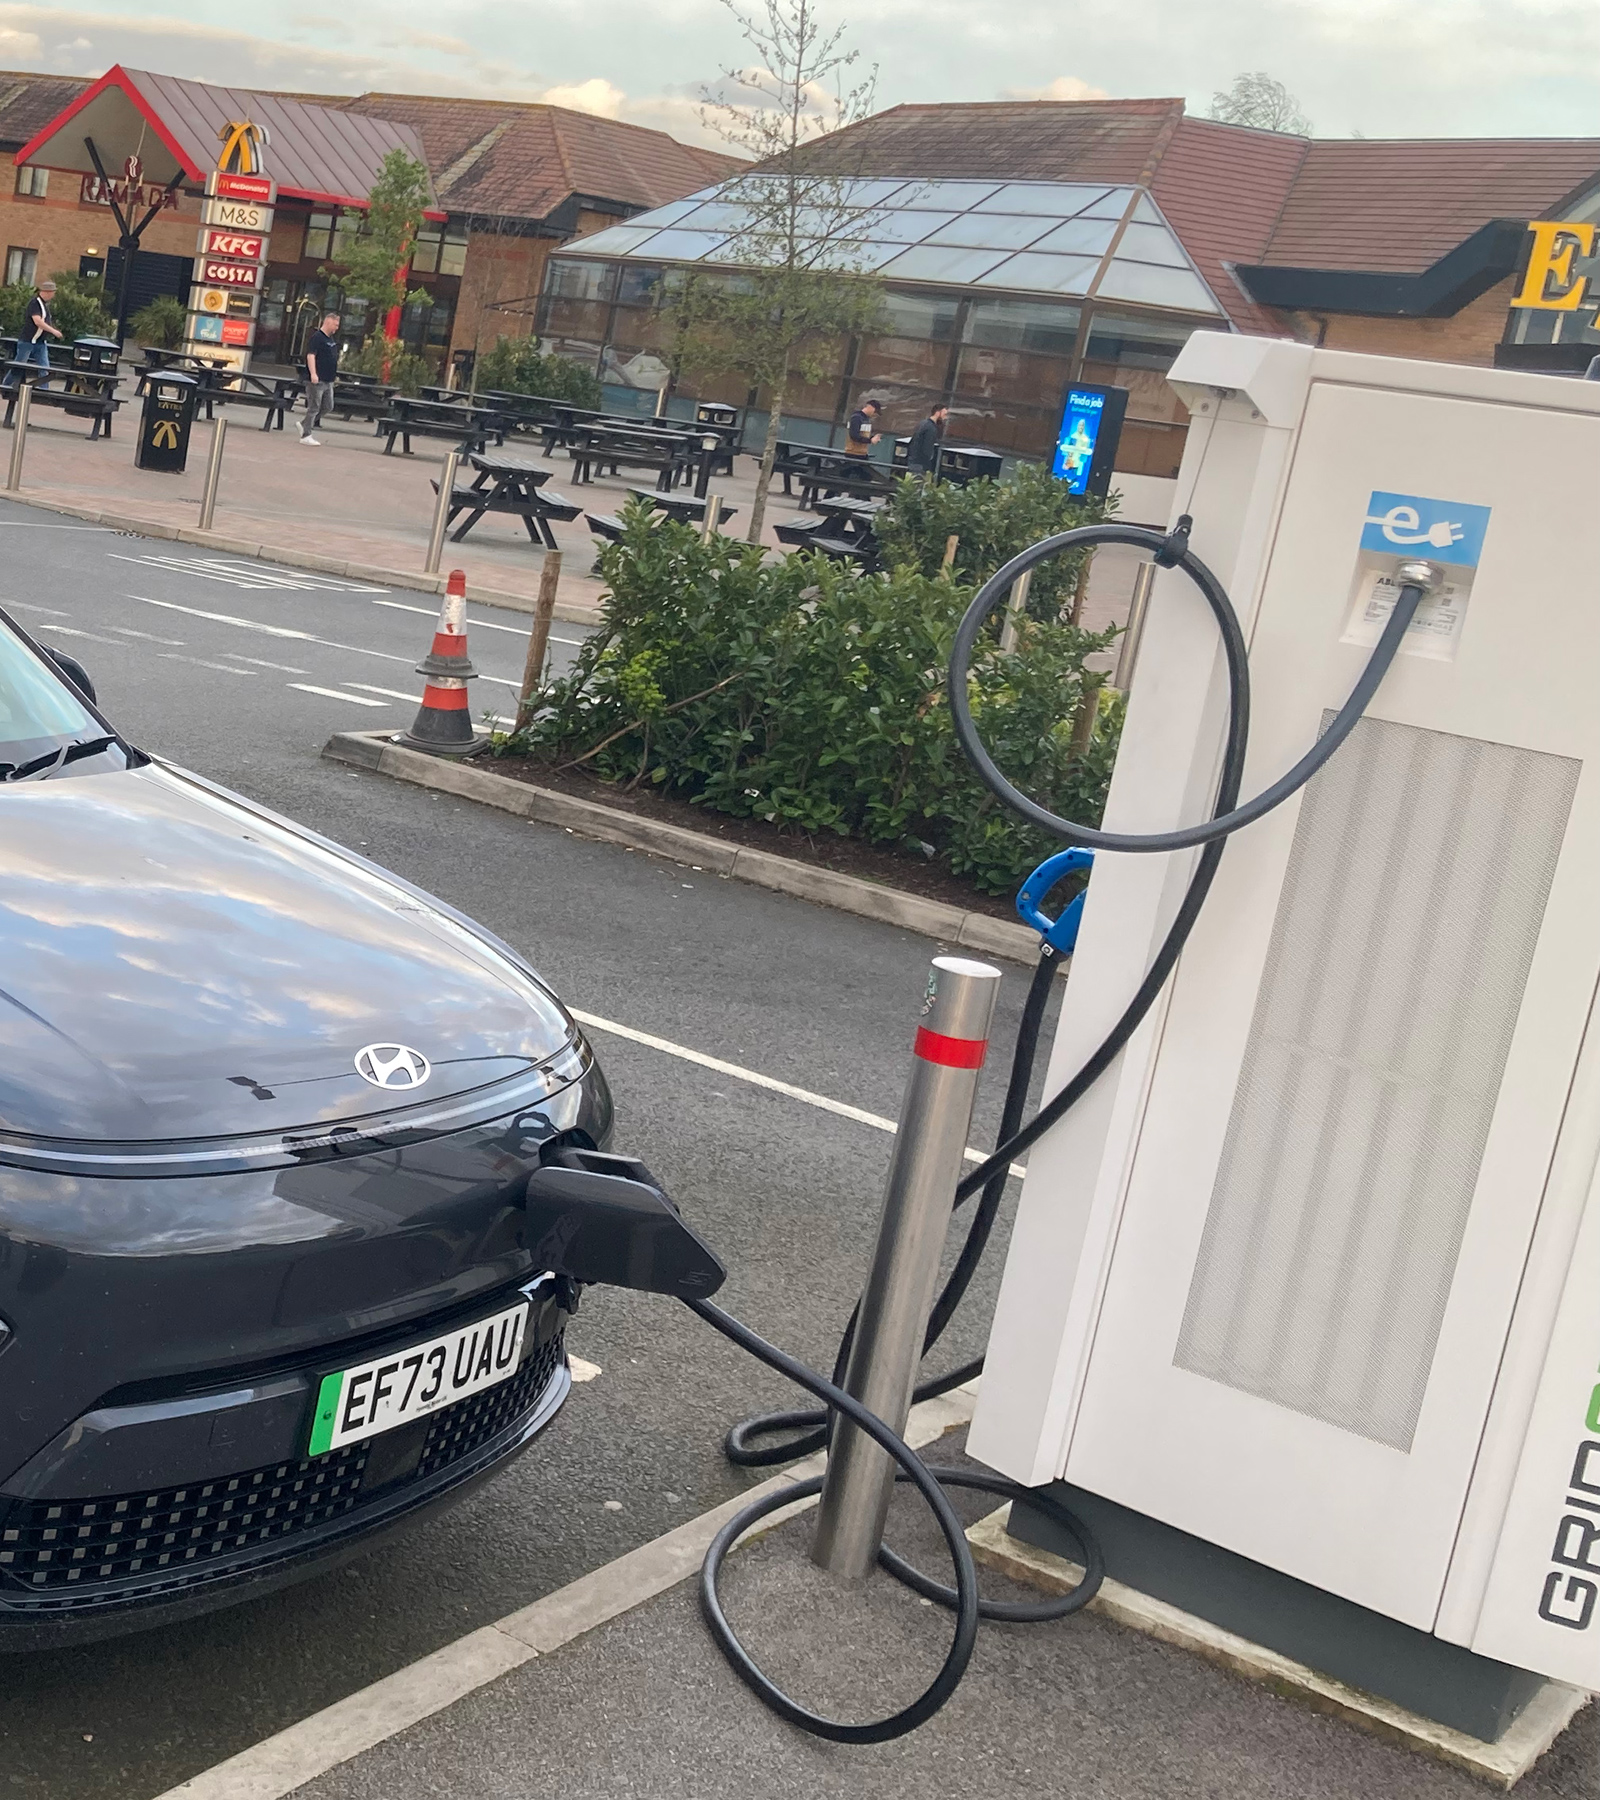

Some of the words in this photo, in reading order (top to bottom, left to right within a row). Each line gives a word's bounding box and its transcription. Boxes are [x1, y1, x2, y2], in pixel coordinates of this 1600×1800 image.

[220, 206, 260, 226] M&S
[210, 235, 260, 256] KFC
[207, 265, 254, 283] COSTA
[341, 1345, 447, 1433] EF73
[452, 1313, 521, 1389] UAU
